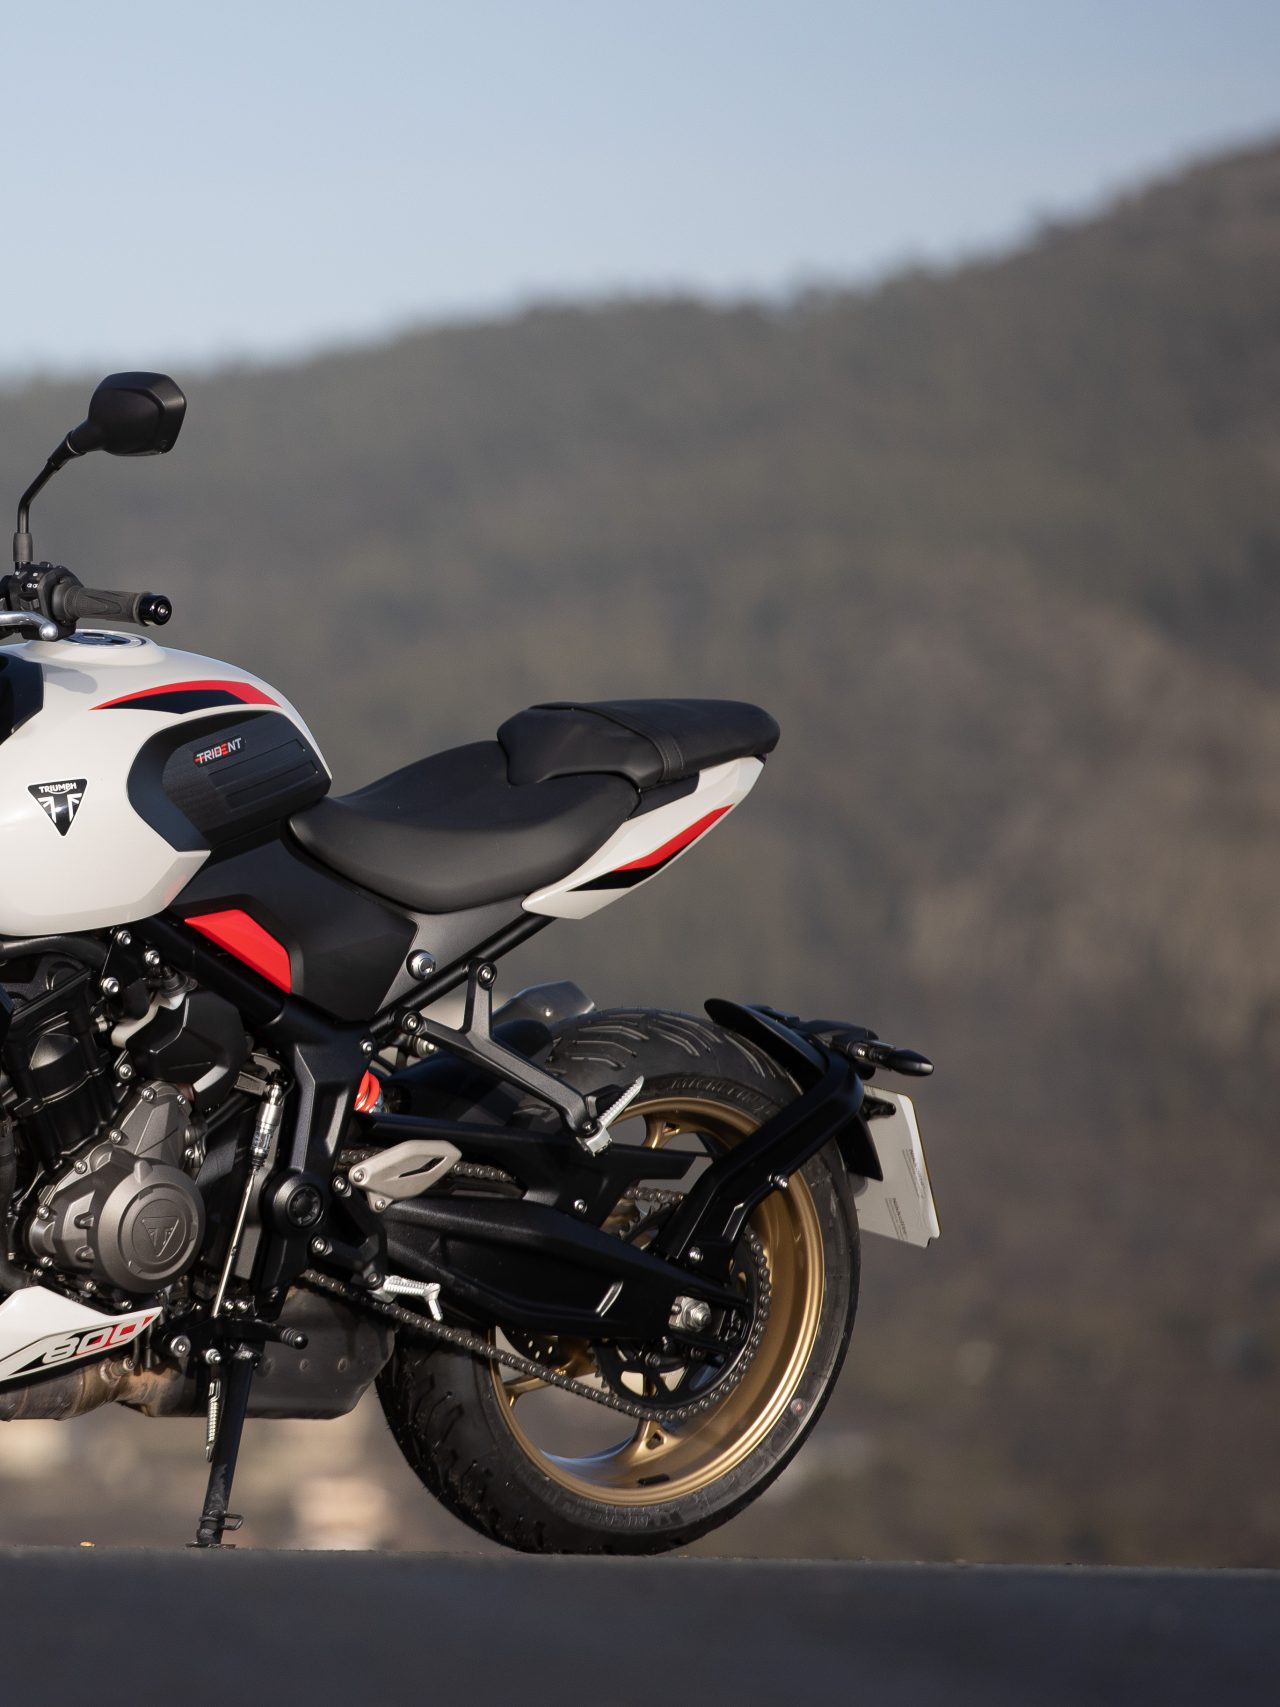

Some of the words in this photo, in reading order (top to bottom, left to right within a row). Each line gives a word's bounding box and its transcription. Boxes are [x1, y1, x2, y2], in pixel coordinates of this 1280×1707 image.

[196, 737, 242, 764] TRIDENT
[38, 782, 77, 794] TRIUMPH
[42, 1317, 145, 1365] 800
